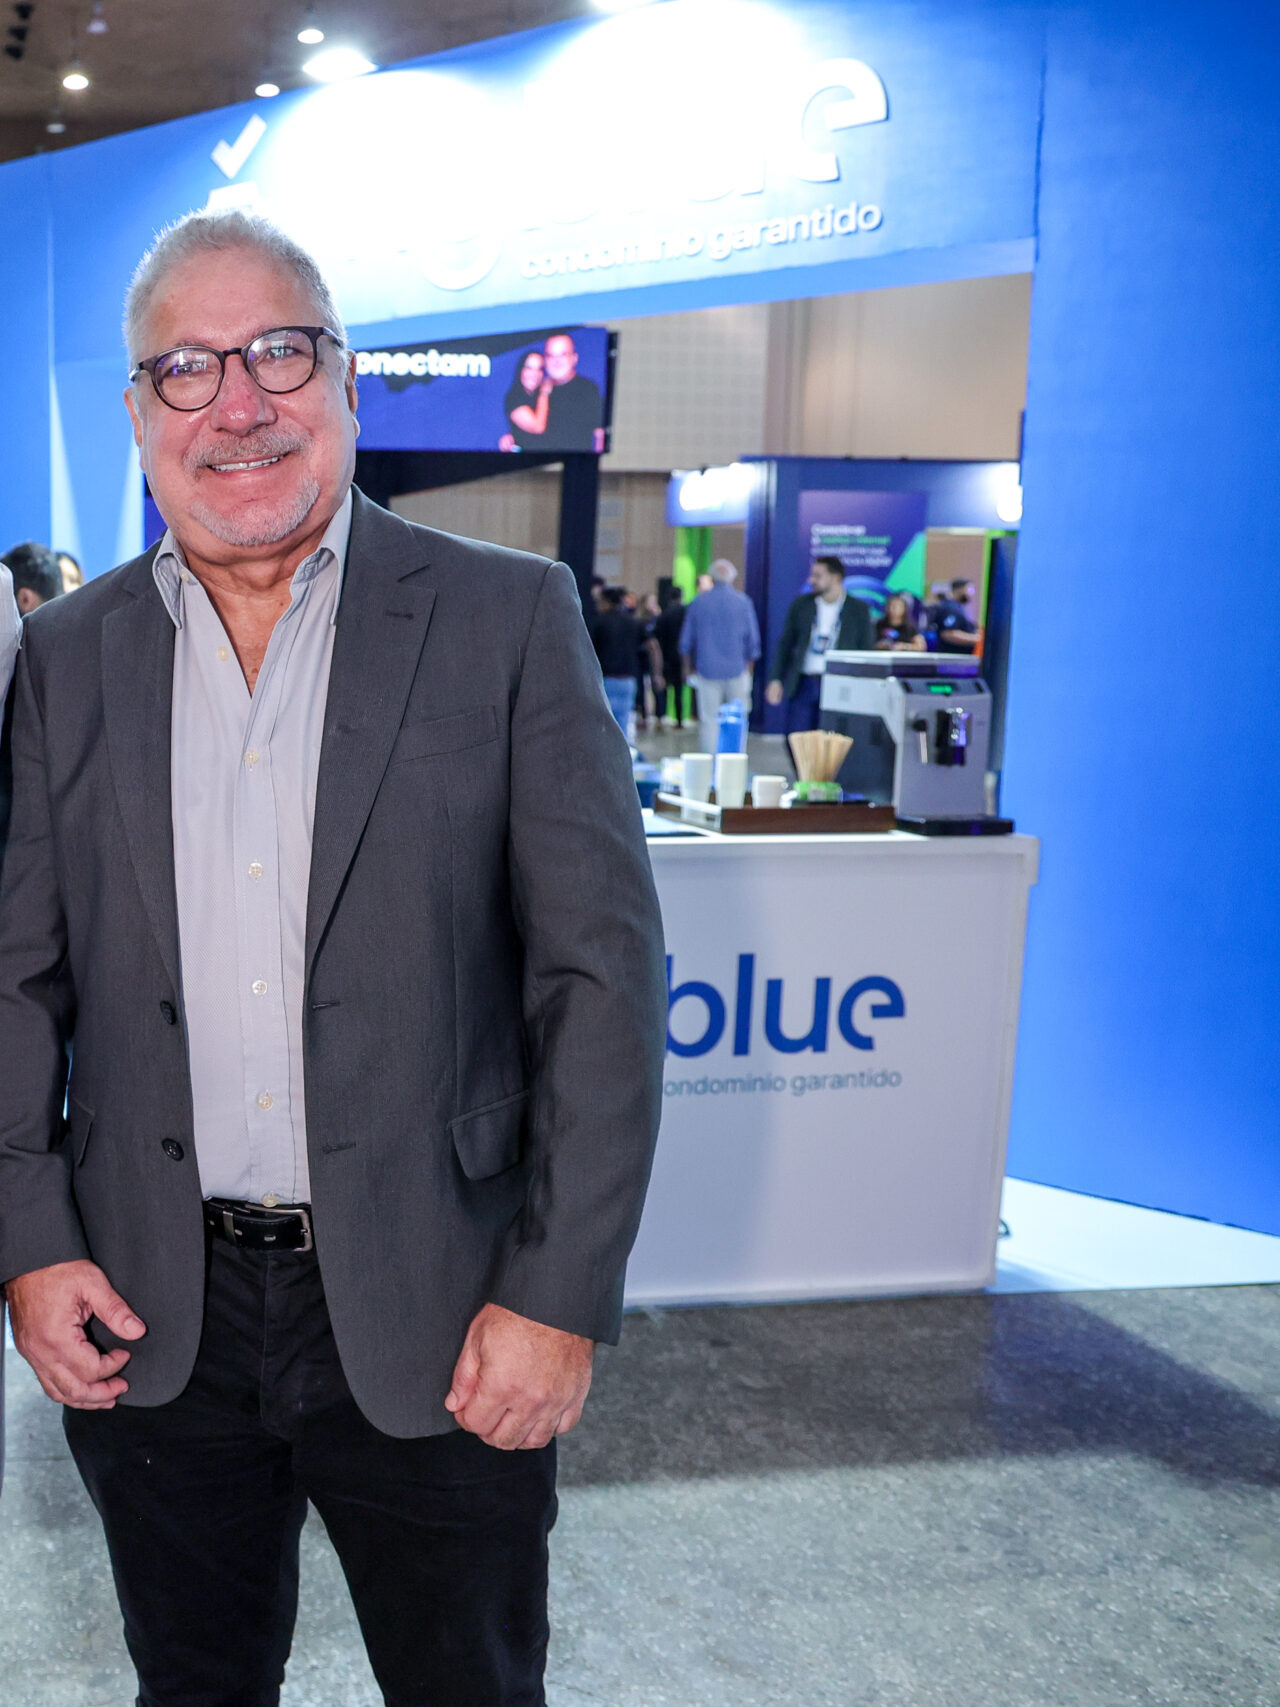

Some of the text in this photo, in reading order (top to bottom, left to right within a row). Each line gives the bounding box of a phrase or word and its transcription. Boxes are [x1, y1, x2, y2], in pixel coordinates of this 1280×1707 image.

[709, 201, 883, 260] garantido
[357, 349, 491, 377] onectam
[665, 953, 906, 1059] blue
[664, 1068, 903, 1097] ondominio garantido
